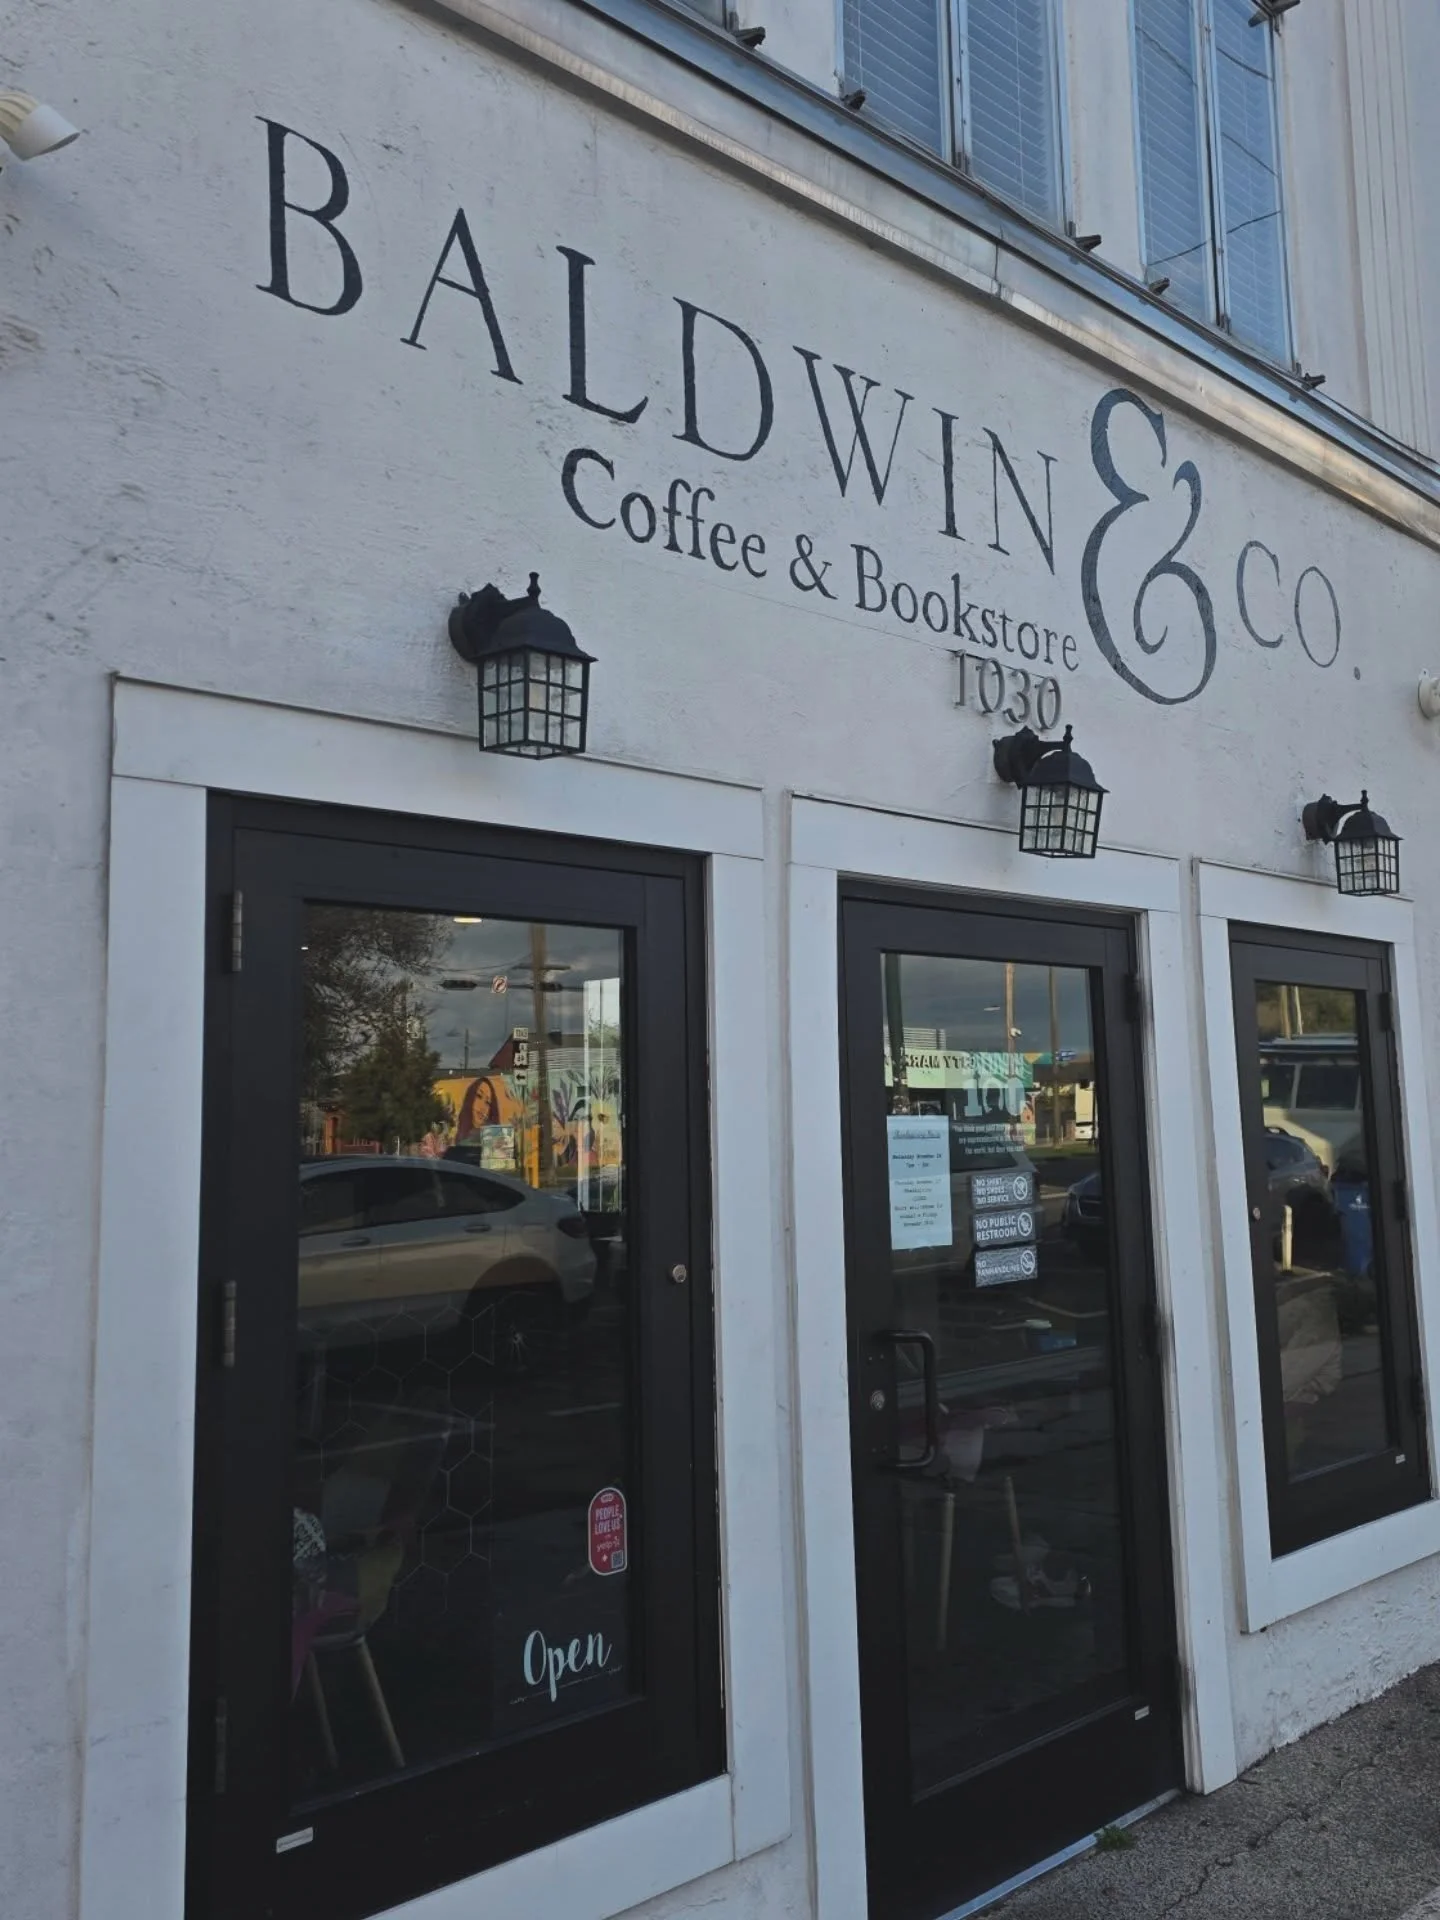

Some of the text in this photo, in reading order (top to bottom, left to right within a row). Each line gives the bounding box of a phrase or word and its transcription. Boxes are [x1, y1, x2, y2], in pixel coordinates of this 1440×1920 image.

[255, 115, 1058, 575] BALDWIN
[1081, 388, 1217, 705] &
[561, 448, 1080, 672] Coffee & Bookstore
[951, 649, 1063, 730] 1030
[976, 1215, 1016, 1229] NO PUBLIC
[976, 1227, 1018, 1241] RESTROOM
[594, 1518, 621, 1535] LOVE US
[595, 1505, 620, 1521] PEOPLE
[523, 1630, 613, 1702] Open
